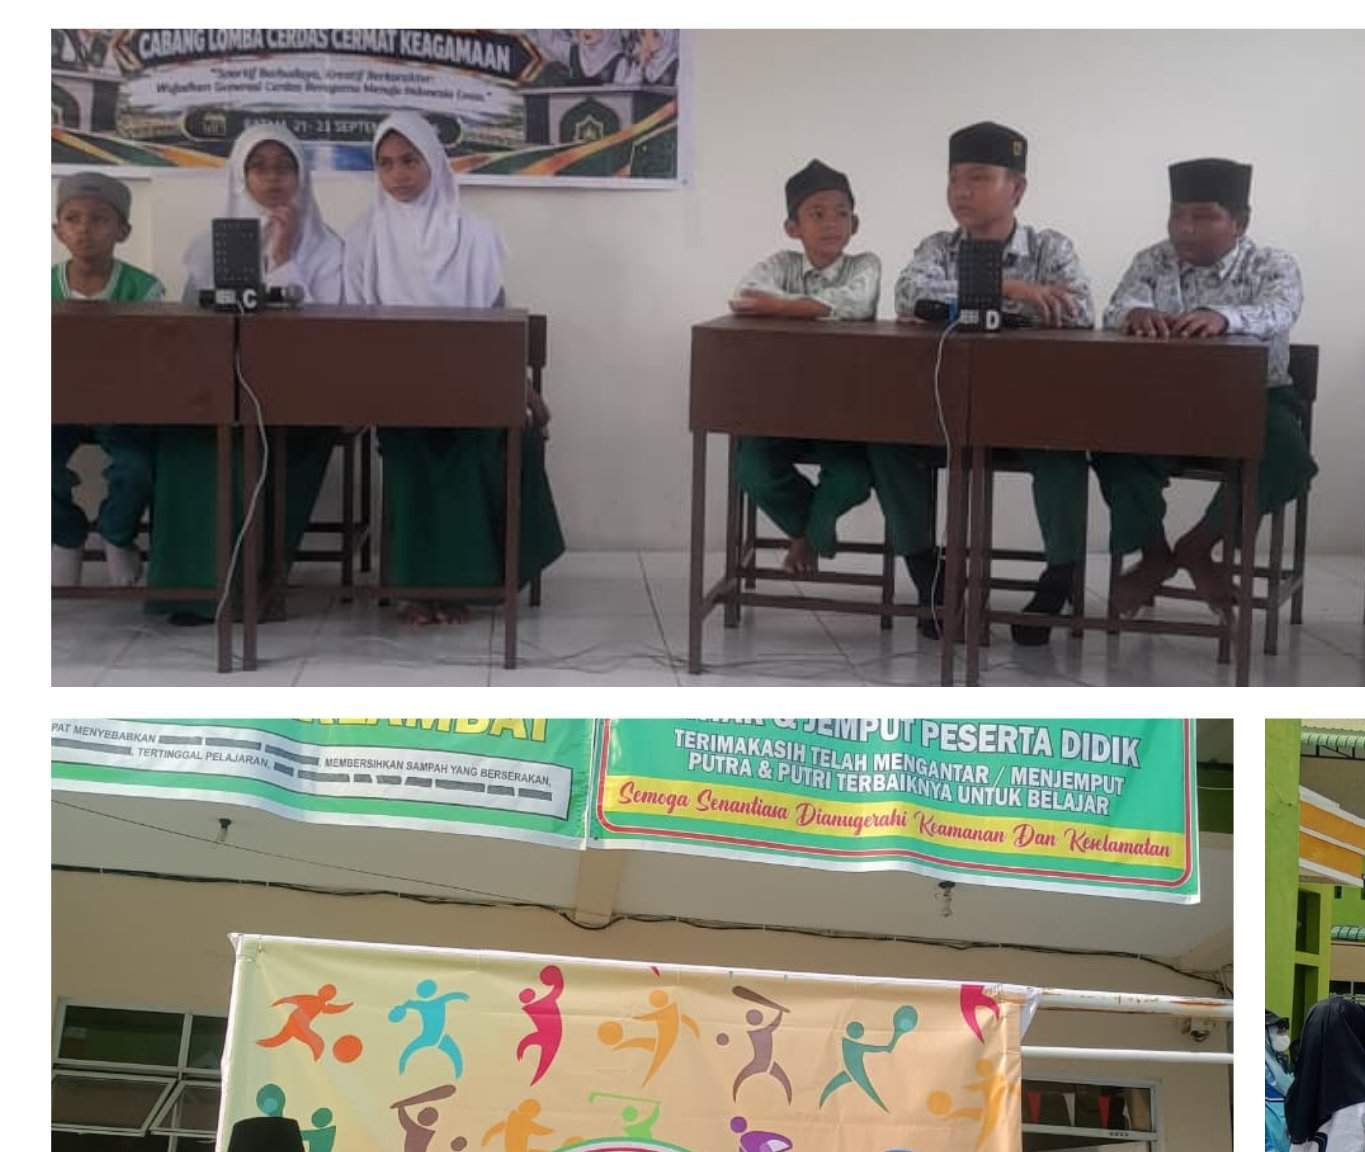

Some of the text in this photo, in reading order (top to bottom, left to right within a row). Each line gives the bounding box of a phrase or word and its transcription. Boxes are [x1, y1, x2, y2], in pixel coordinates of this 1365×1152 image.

[139, 29, 511, 72] CABANG LOMBA CERDAS CERMAT KEAGAMAAN
[242, 288, 257, 309] C
[986, 310, 1000, 330] D
[138, 748, 202, 761] TERTINGGAL
[674, 728, 806, 762] TERIMAKASIH
[811, 746, 867, 771] TELAH
[873, 751, 989, 784] MENGANTAR
[1010, 766, 1125, 796] MENJEMPUT
[920, 719, 1053, 757] PESERTA
[1061, 728, 1142, 768] DIDIK
[325, 757, 404, 770] MEMBERSIHKAN
[406, 760, 447, 775] SAMPAH
[450, 765, 478, 778] YANG
[688, 751, 1110, 816] PUTRA & PUTRI TERBAIKNYA UNTUK BELAJAR
[618, 780, 1172, 858] Semoga Senantiasa Dianugerahi Keamanan Dan Keselamatan
